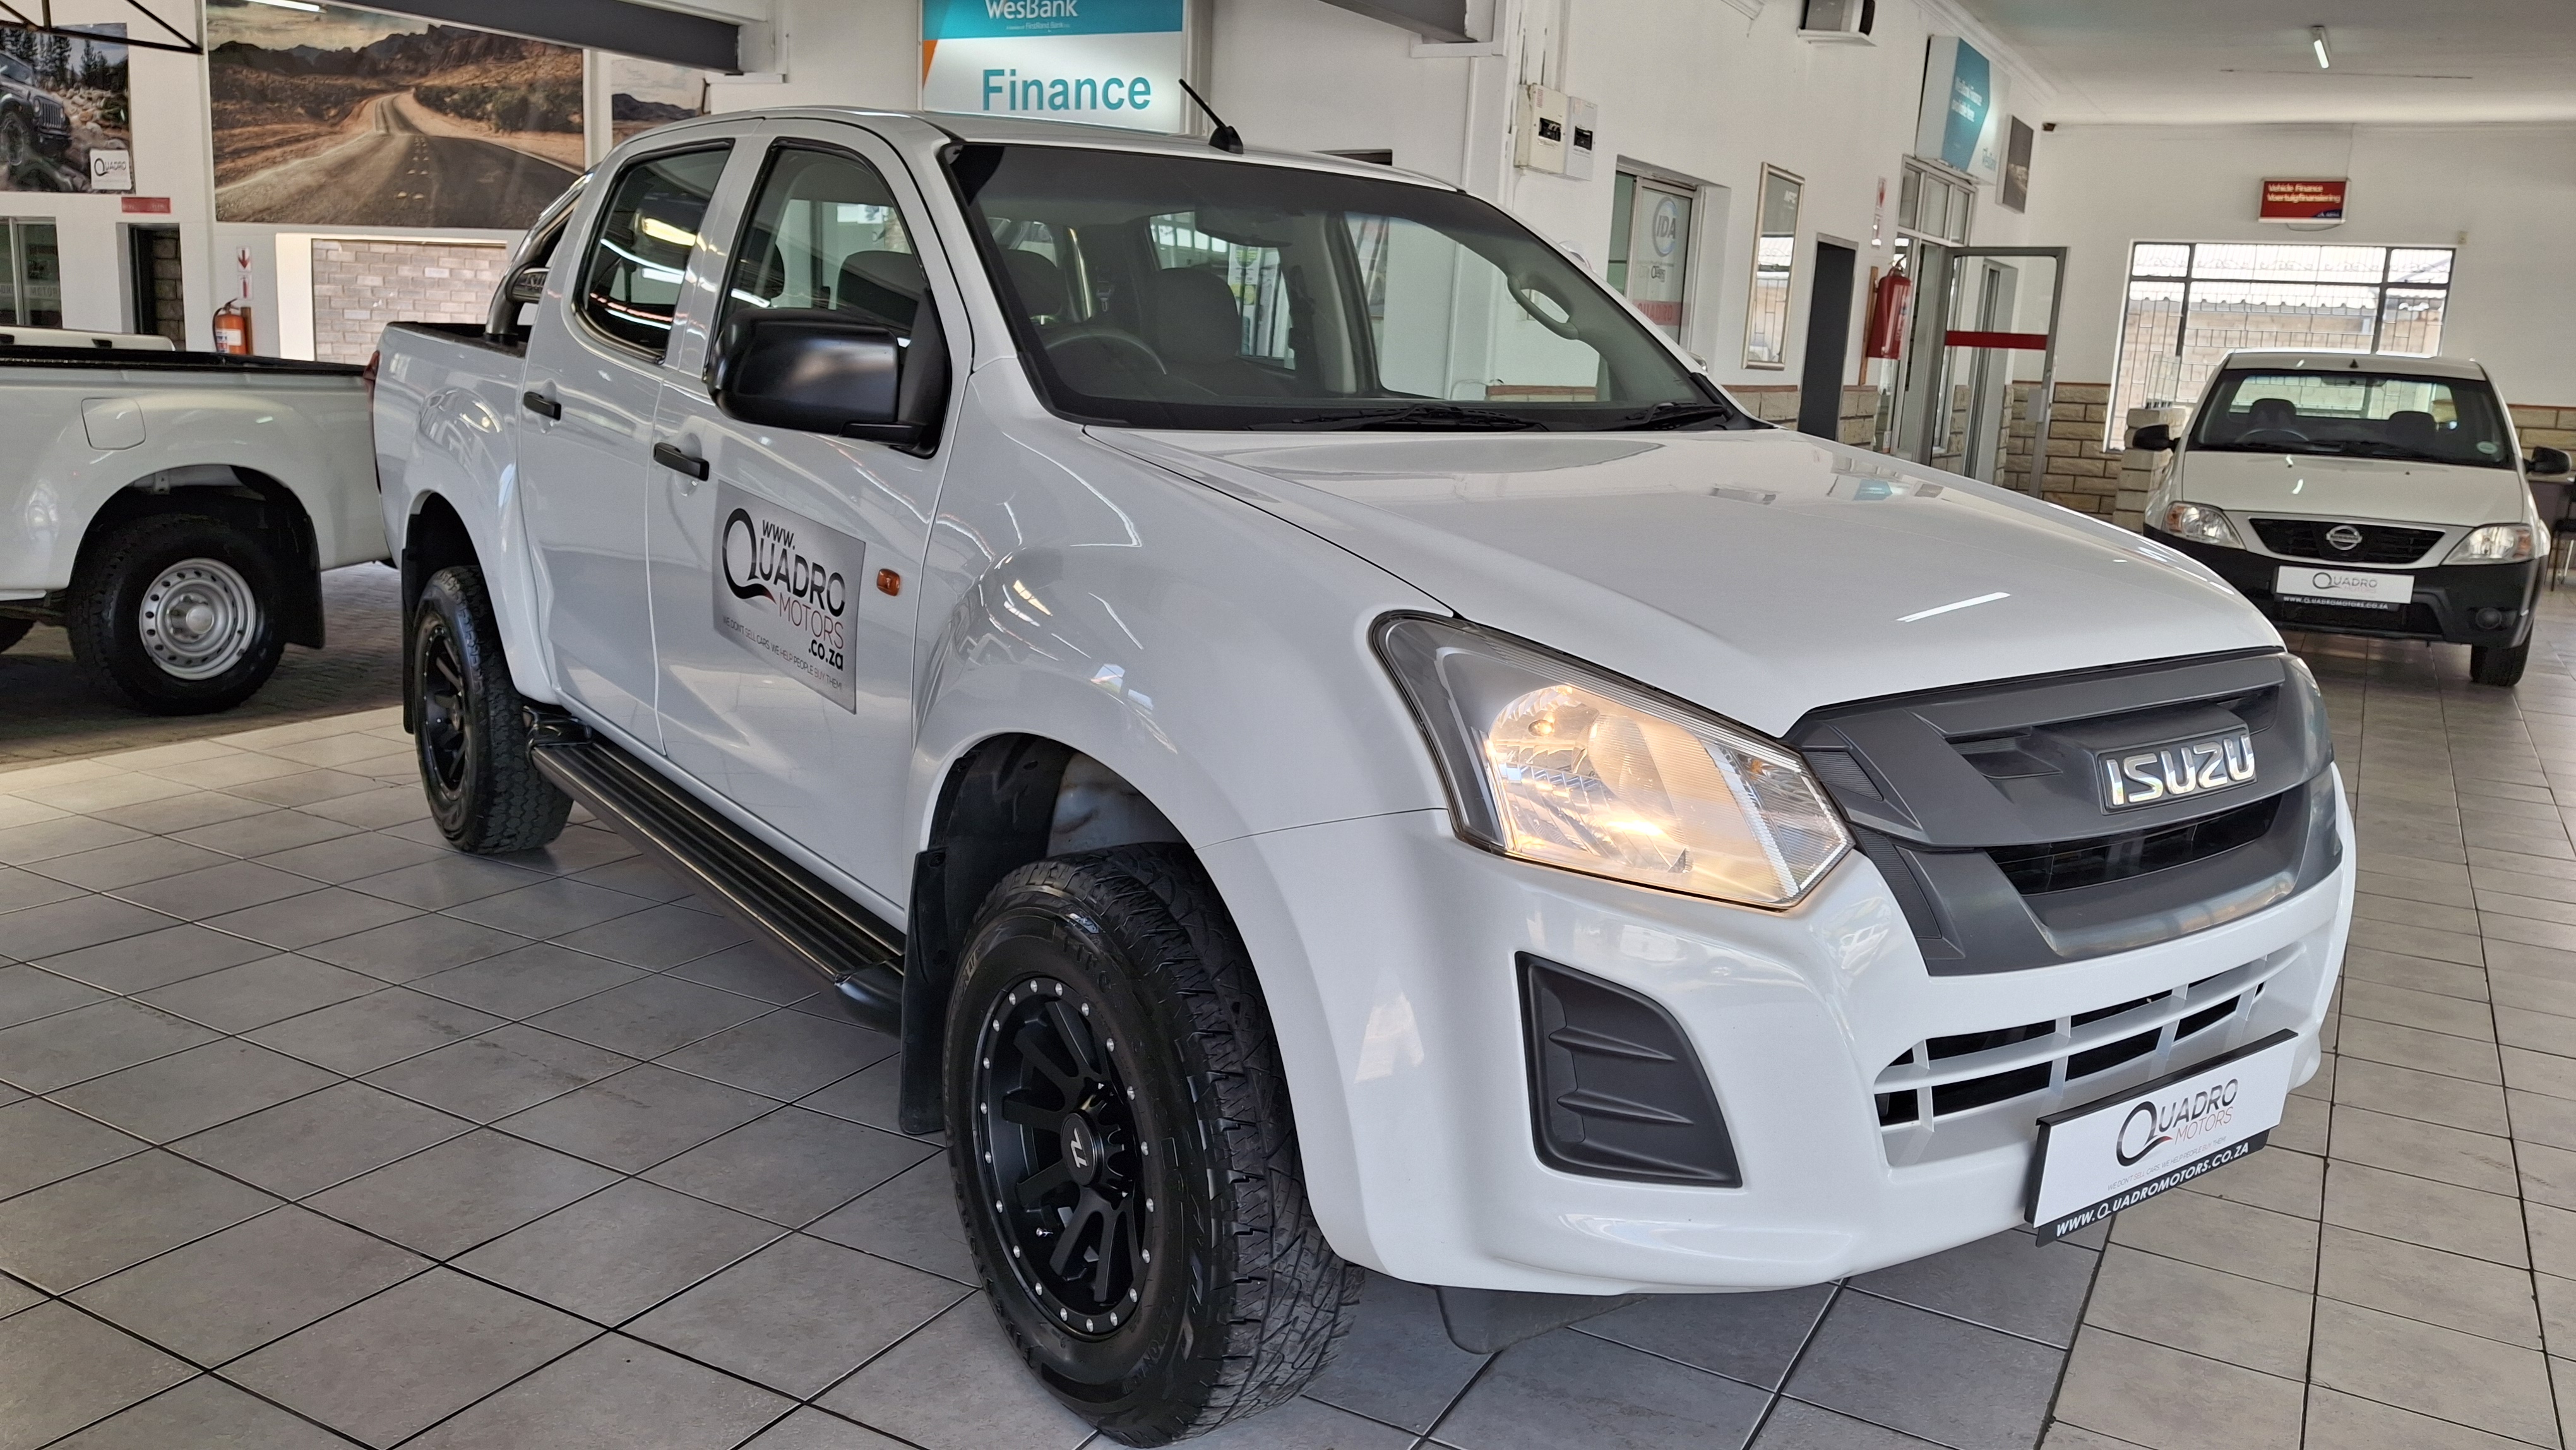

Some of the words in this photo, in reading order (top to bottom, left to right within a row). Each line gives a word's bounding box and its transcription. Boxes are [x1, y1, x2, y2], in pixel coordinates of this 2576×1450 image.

[986, 0, 1078, 19] WesBank
[982, 69, 1152, 111] Finance
[762, 520, 795, 550] www.
[722, 508, 845, 617] QUADRO
[2312, 572, 2378, 589] QUADRO
[779, 592, 844, 650] MOTORS
[794, 656, 814, 676] PEOPLE
[813, 667, 826, 680] BUY
[808, 639, 844, 671] .co.za
[2106, 734, 2255, 806] ISUZU
[2116, 1078, 2238, 1167] QUADRO
[2174, 1106, 2234, 1146] MOTORS
[2056, 1142, 2249, 1237] WWW.QUADROMOTORS.CO.ZA
